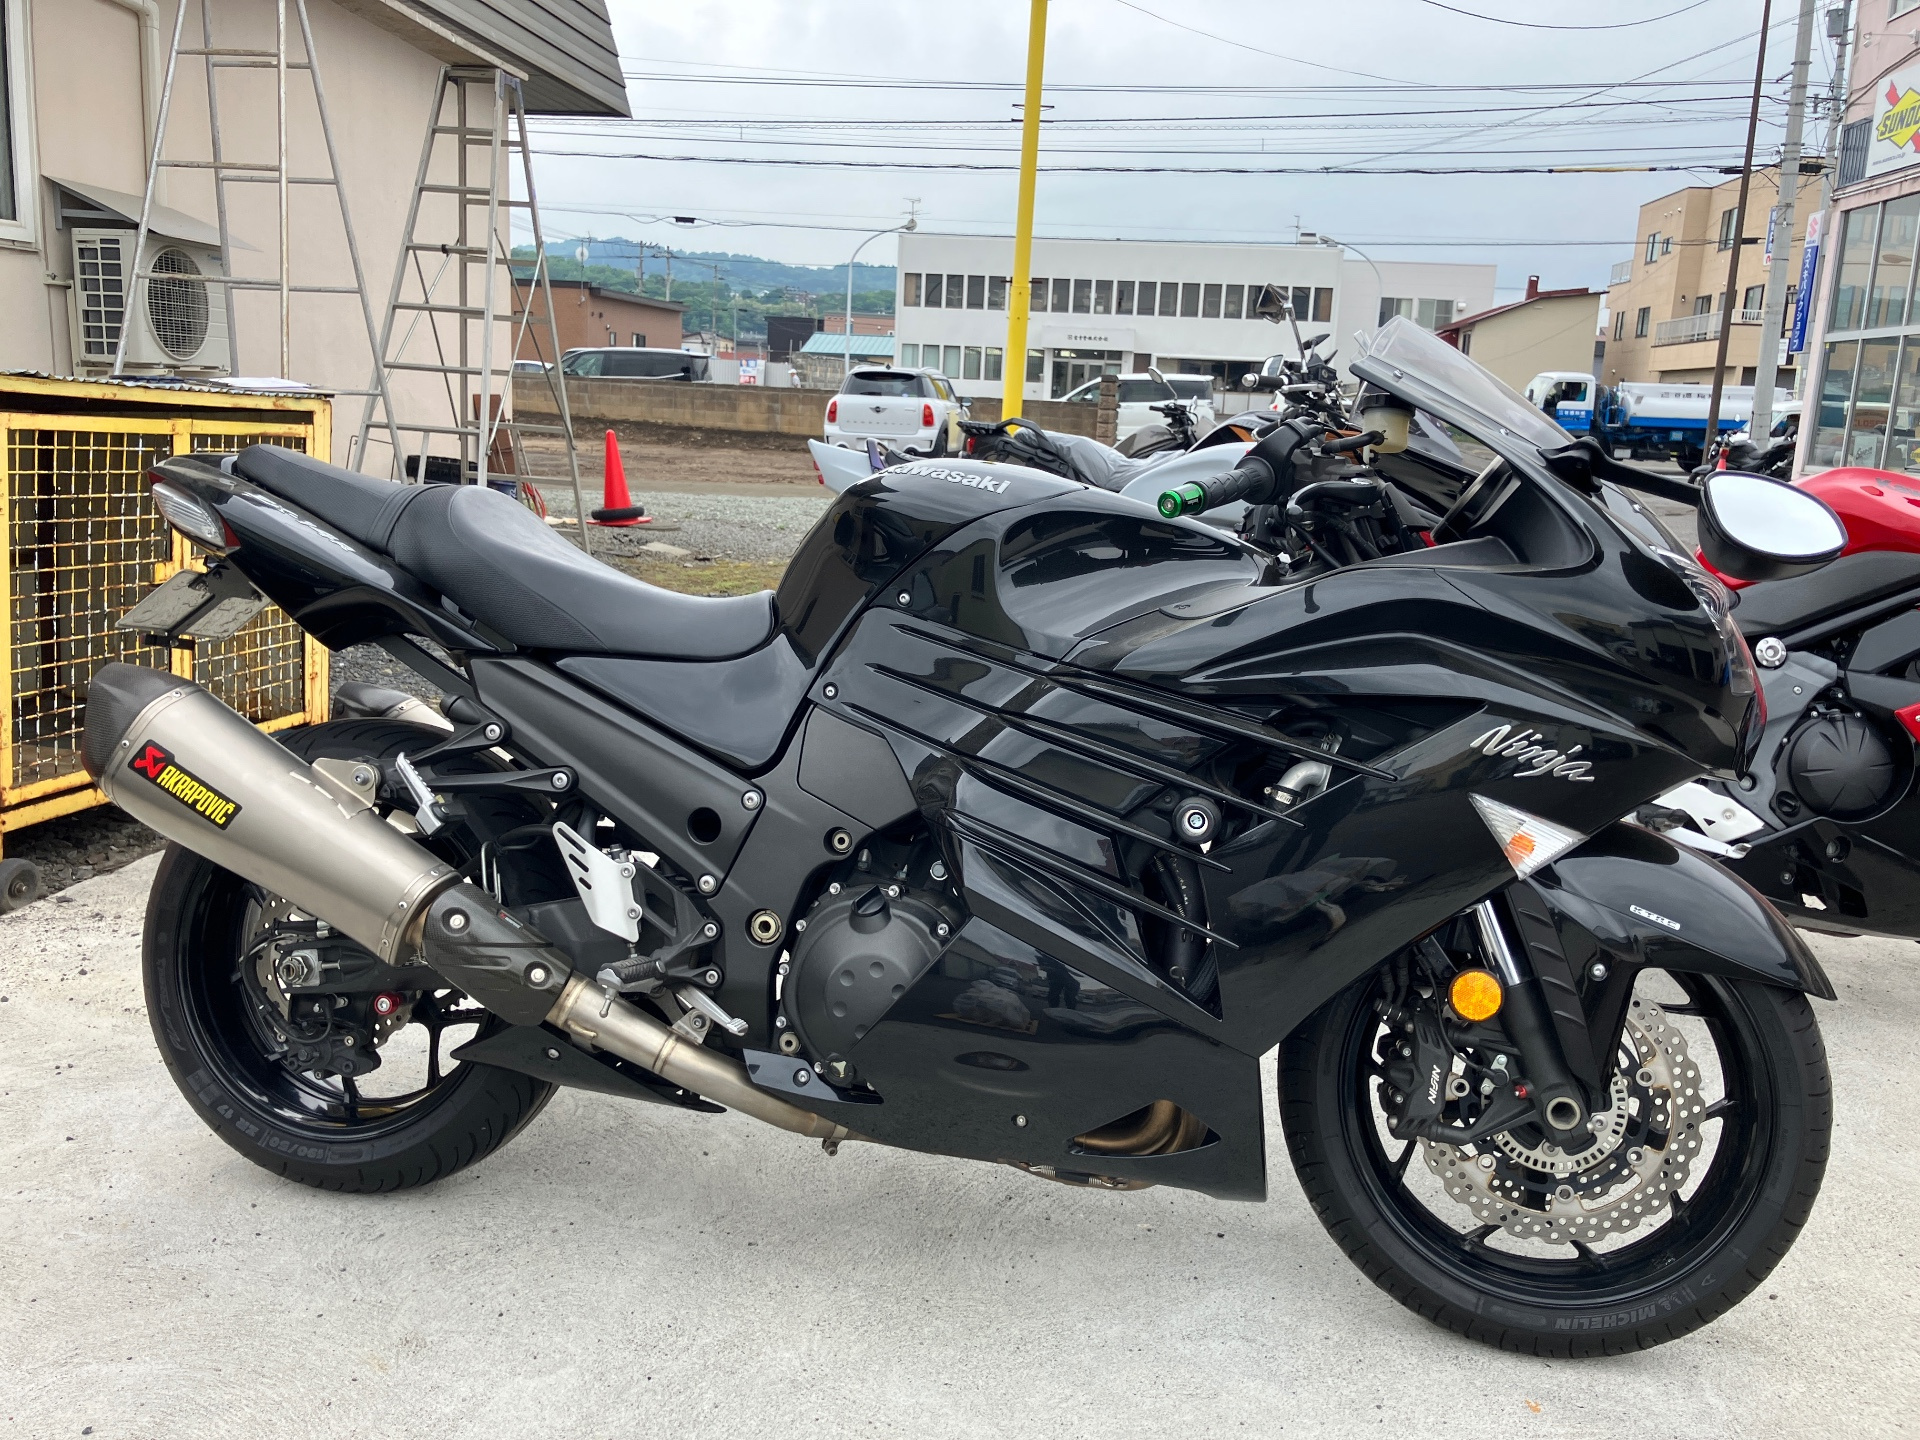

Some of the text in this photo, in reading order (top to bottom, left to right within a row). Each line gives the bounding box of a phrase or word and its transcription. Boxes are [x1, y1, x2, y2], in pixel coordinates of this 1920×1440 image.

[1793, 248, 1812, 349] スズキバイクショップ
[1469, 724, 1595, 783] Ninja
[156, 765, 236, 825] AKRAPOVIČ
[1554, 1303, 1657, 1330] MICHELIN
